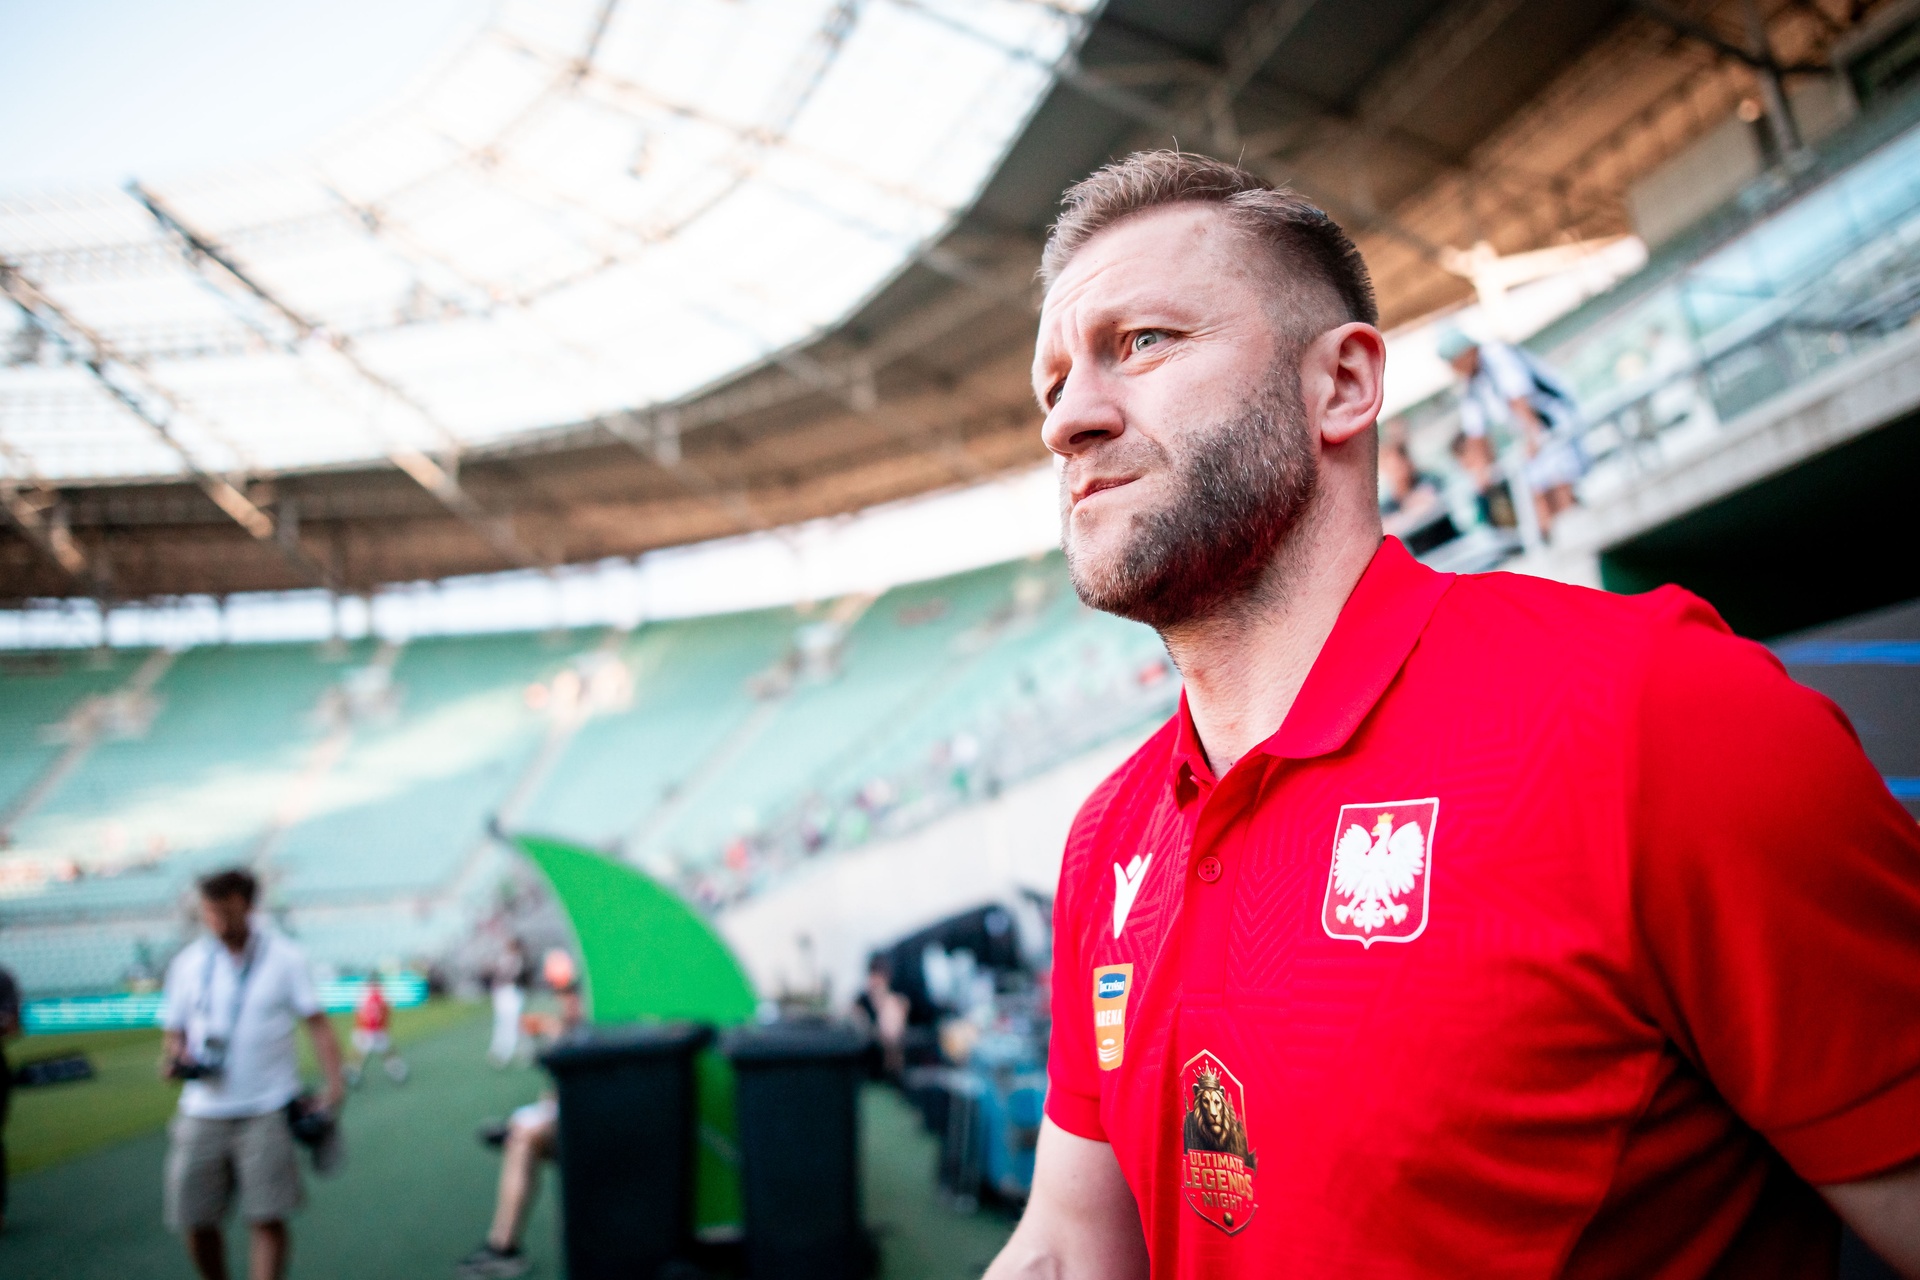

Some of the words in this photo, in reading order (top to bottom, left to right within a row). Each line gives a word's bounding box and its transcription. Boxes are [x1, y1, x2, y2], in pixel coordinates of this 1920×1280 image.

[1096, 1009, 1122, 1027] ARENA
[1189, 1151, 1244, 1174] ULTIMATE
[1183, 1159, 1254, 1201] LEGENDS
[1201, 1191, 1243, 1212] NIGHT
